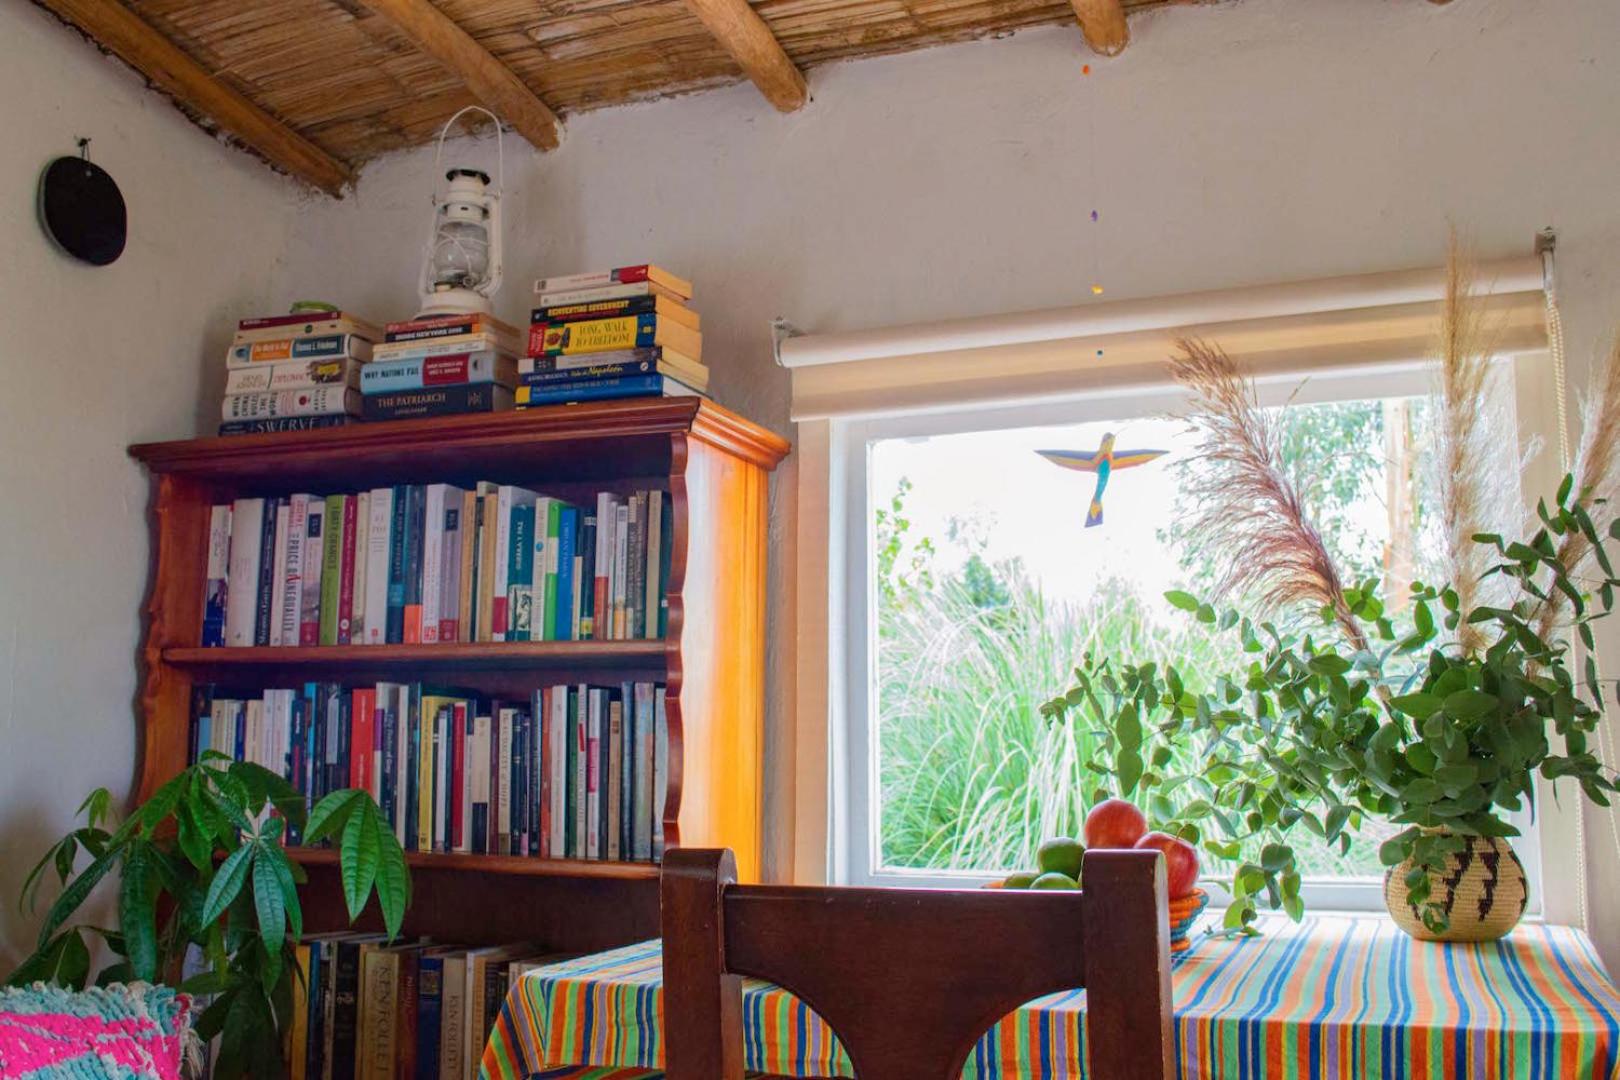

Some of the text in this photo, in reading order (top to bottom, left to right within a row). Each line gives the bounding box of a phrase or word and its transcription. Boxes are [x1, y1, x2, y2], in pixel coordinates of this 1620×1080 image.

[579, 320, 628, 337] LONG WALK
[589, 333, 631, 347] FREEDOM
[364, 370, 378, 380] WHY
[381, 368, 405, 379] NATIONS
[378, 393, 447, 409] THE PATRIARCH
[258, 418, 313, 433] SWERVE
[287, 539, 299, 565] PRICE
[283, 582, 296, 633] INEQUALITY
[377, 967, 391, 1003] KEN
